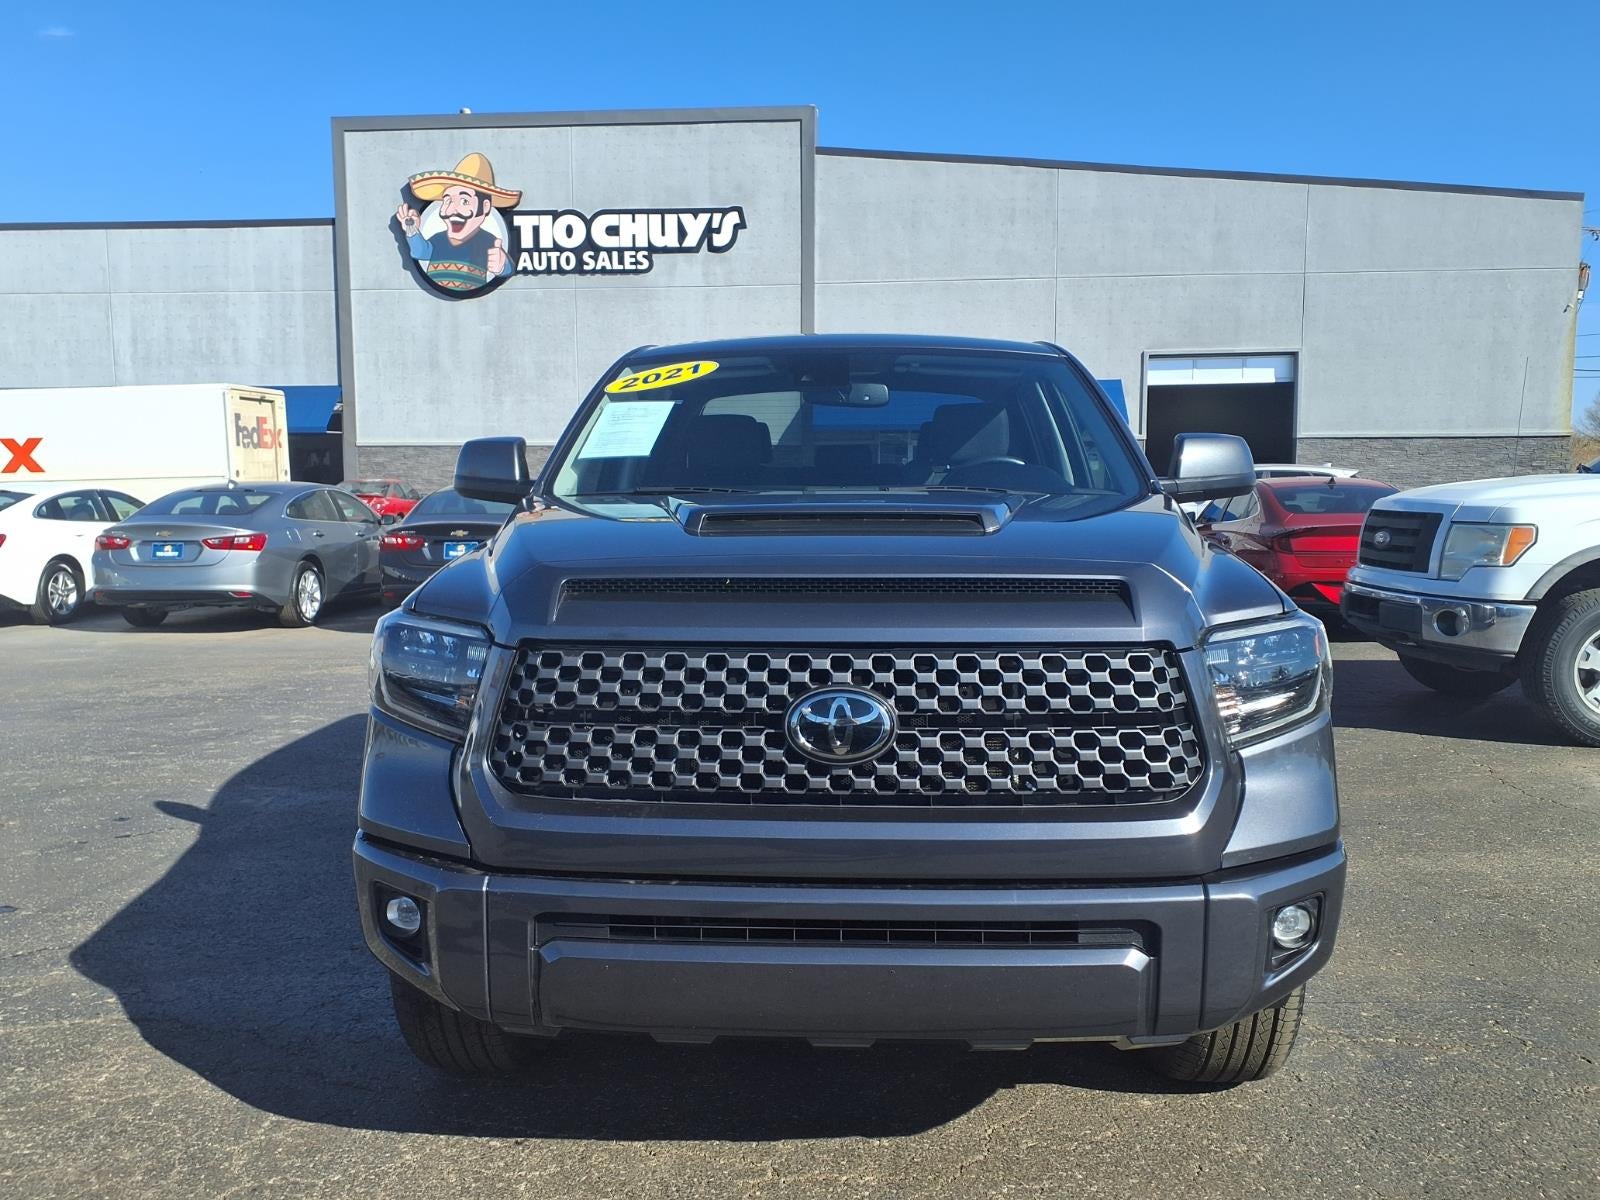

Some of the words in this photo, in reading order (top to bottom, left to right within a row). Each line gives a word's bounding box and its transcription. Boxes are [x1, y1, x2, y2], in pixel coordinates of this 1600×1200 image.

[513, 214, 587, 249] TIO
[517, 251, 577, 271] AUTO
[582, 250, 650, 271] SALES
[619, 363, 701, 391] 2021
[234, 412, 283, 449] FedEx
